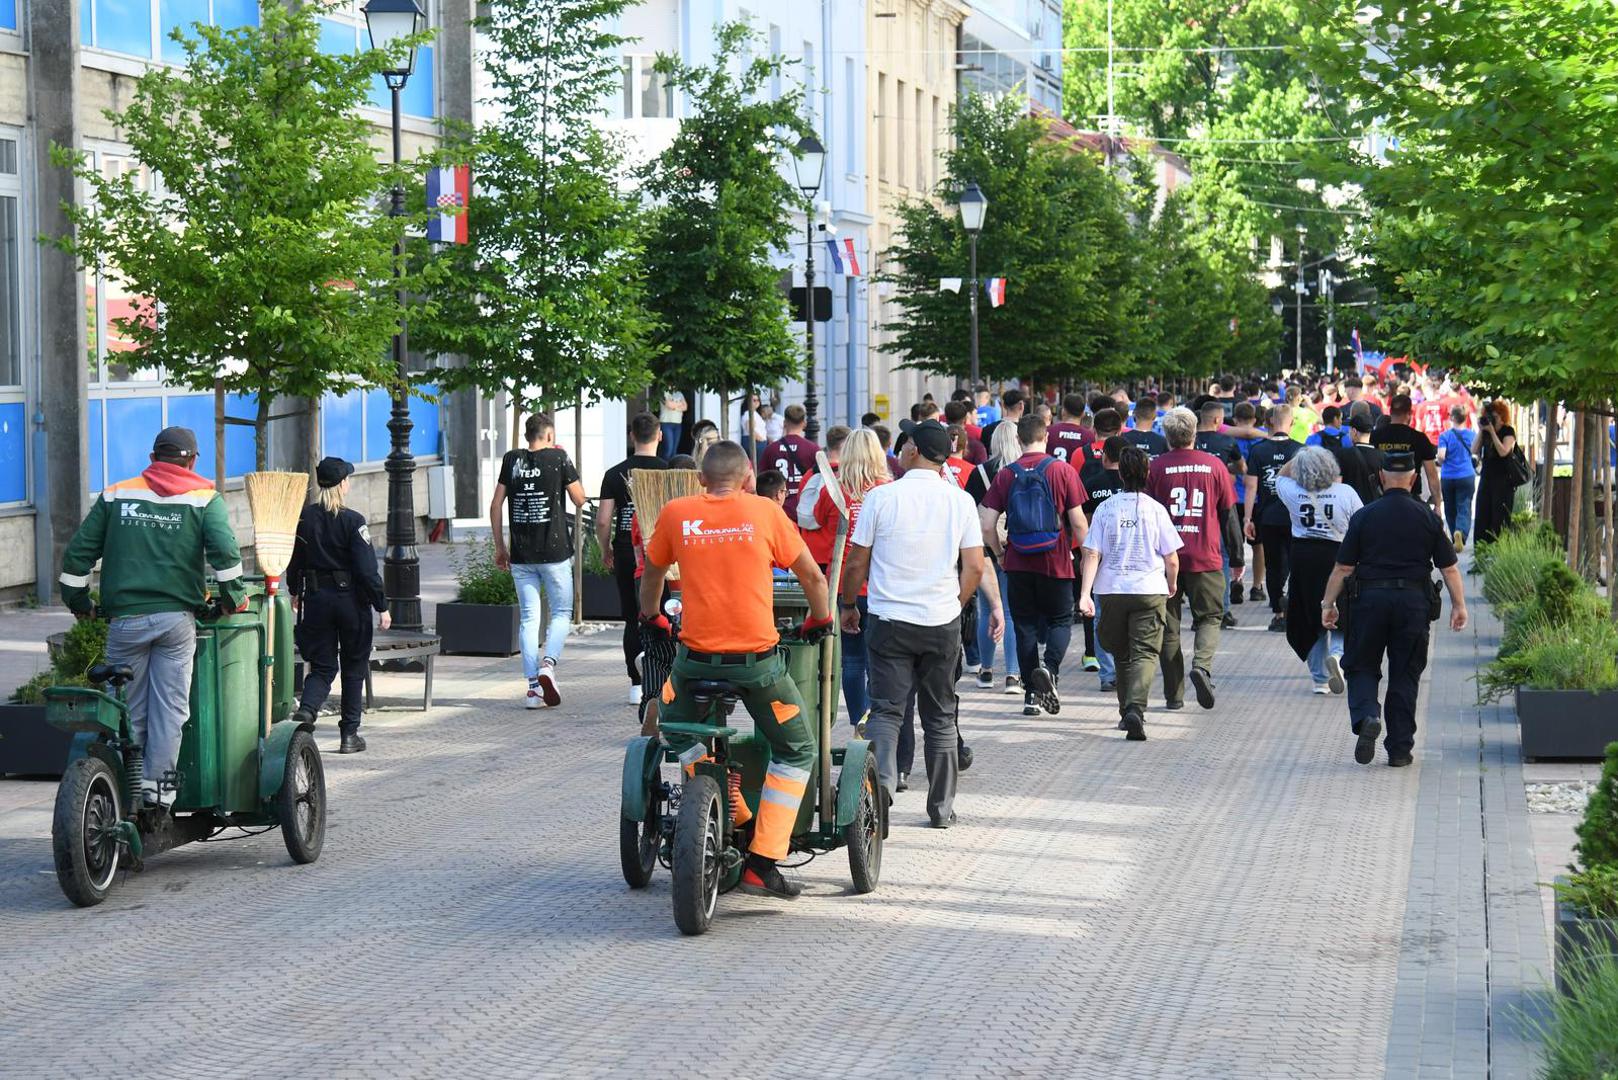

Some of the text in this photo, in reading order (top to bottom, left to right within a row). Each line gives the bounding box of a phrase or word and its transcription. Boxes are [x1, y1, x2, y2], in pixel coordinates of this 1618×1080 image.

[1092, 489, 1113, 499] GORA
[121, 519, 181, 530] BJELOVAR
[684, 535, 753, 546] BJELOVAR
